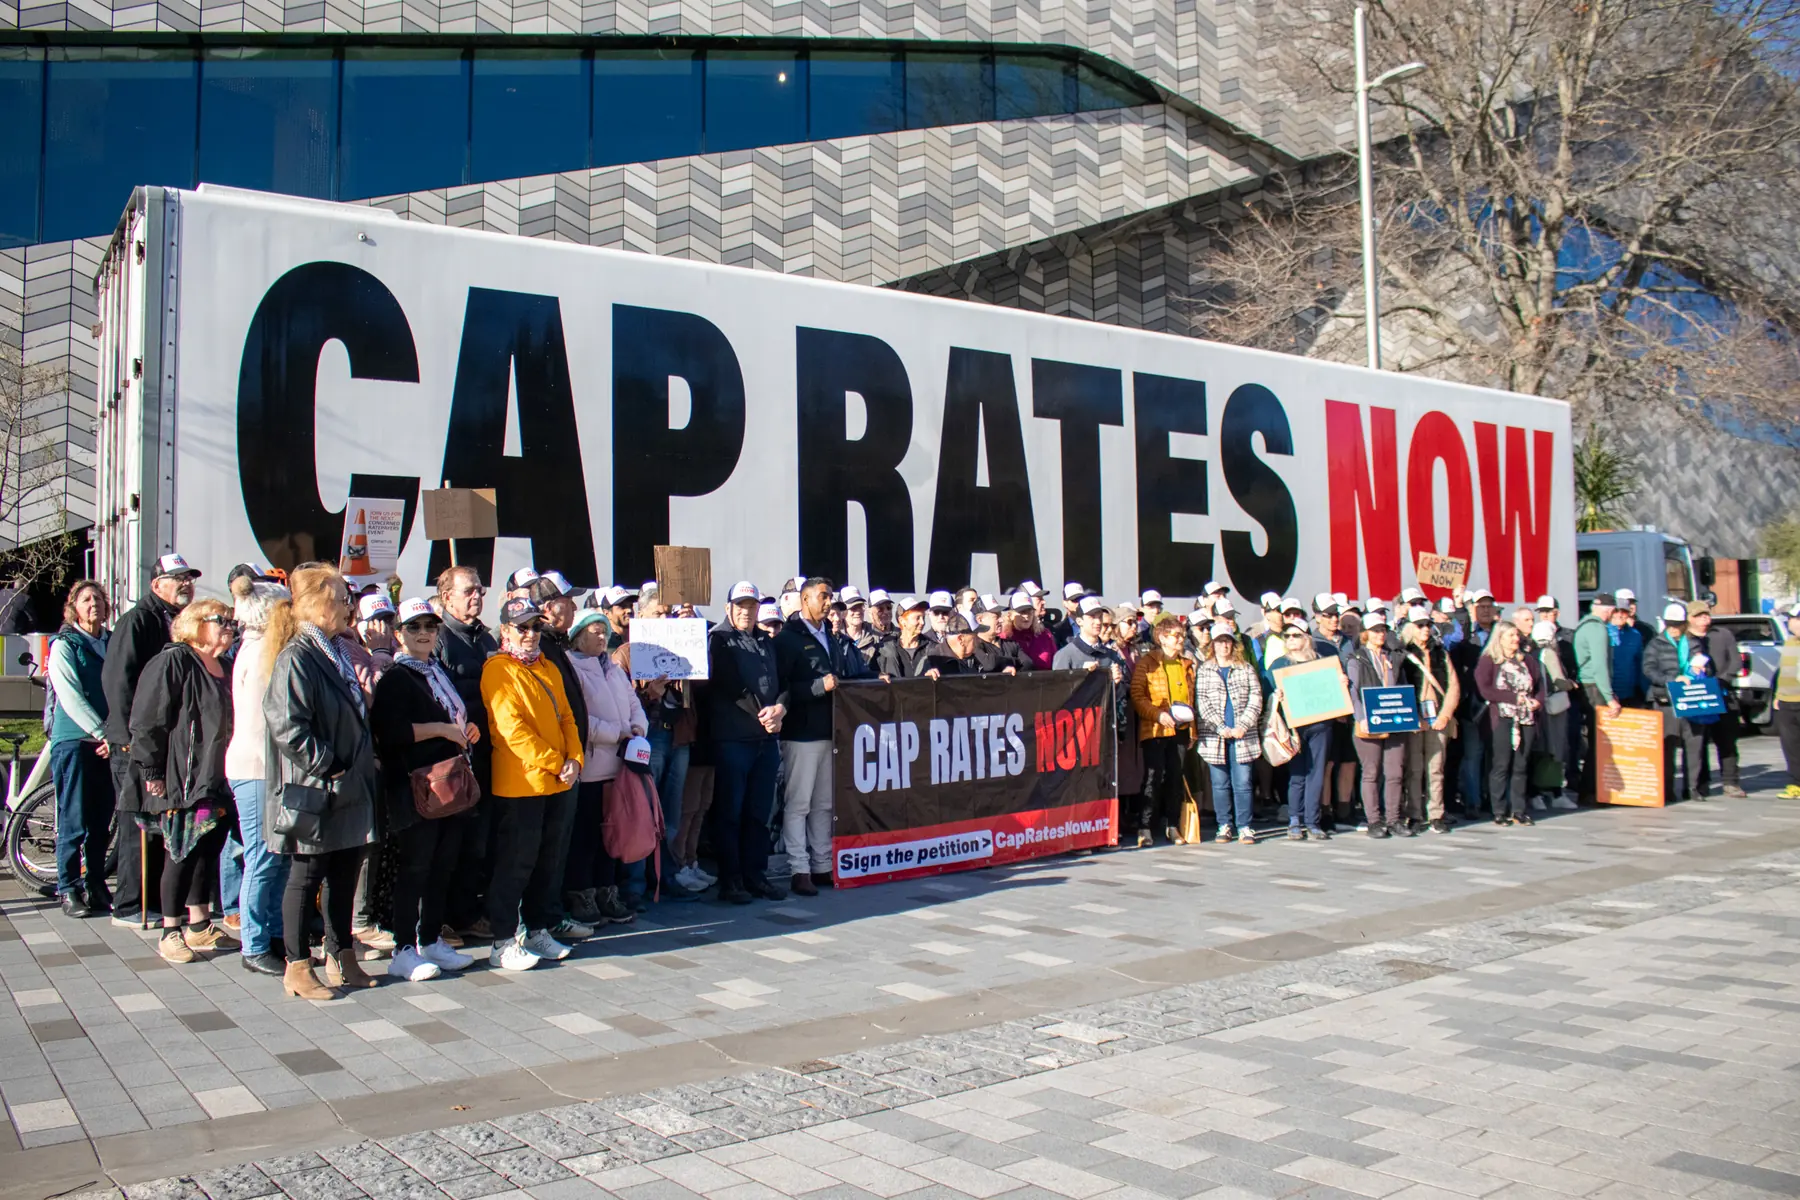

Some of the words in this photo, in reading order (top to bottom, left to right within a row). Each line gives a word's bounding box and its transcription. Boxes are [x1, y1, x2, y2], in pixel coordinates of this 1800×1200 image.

[237, 261, 746, 588] CAP
[796, 326, 1298, 601] RATES
[1325, 399, 1553, 601] NOW
[1421, 556, 1440, 571] CAP
[1440, 559, 1465, 575] RATES
[1431, 574, 1454, 587] NOW
[853, 721, 920, 794] CAP
[929, 713, 1026, 785] RATES
[1034, 706, 1102, 773] NOW
[840, 852, 881, 872] Sign
[886, 848, 914, 865] the
[917, 838, 979, 865] petition
[995, 817, 1110, 850] CapRatesNow.nz
